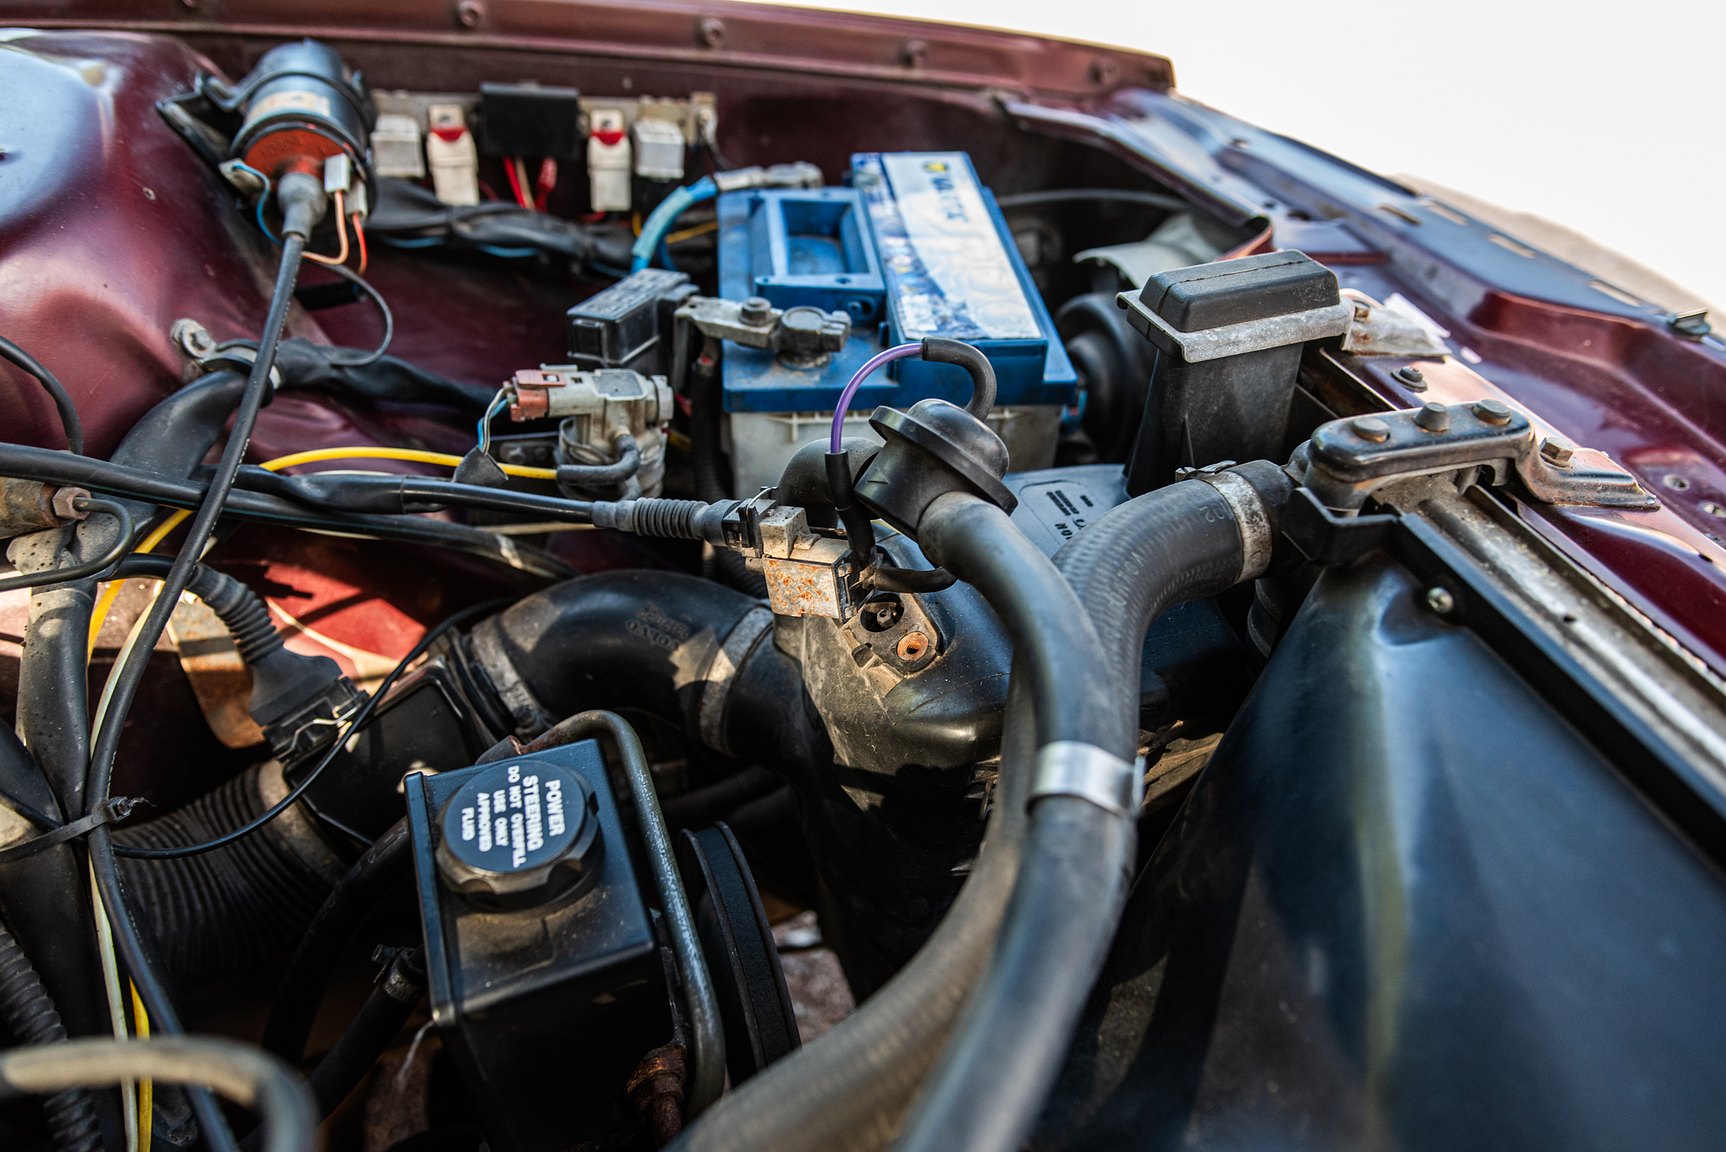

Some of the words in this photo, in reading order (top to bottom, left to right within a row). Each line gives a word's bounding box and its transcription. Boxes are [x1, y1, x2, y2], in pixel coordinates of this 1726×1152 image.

[508, 765, 520, 783] DO
[493, 789, 507, 814] USE
[509, 785, 523, 809] NOT
[522, 775, 544, 851] STEERING
[545, 779, 565, 837] POWER
[461, 806, 475, 841] FLUID
[477, 792, 492, 852] APPROVED
[494, 817, 509, 847] ONLY
[510, 812, 527, 869] OVERFILL
